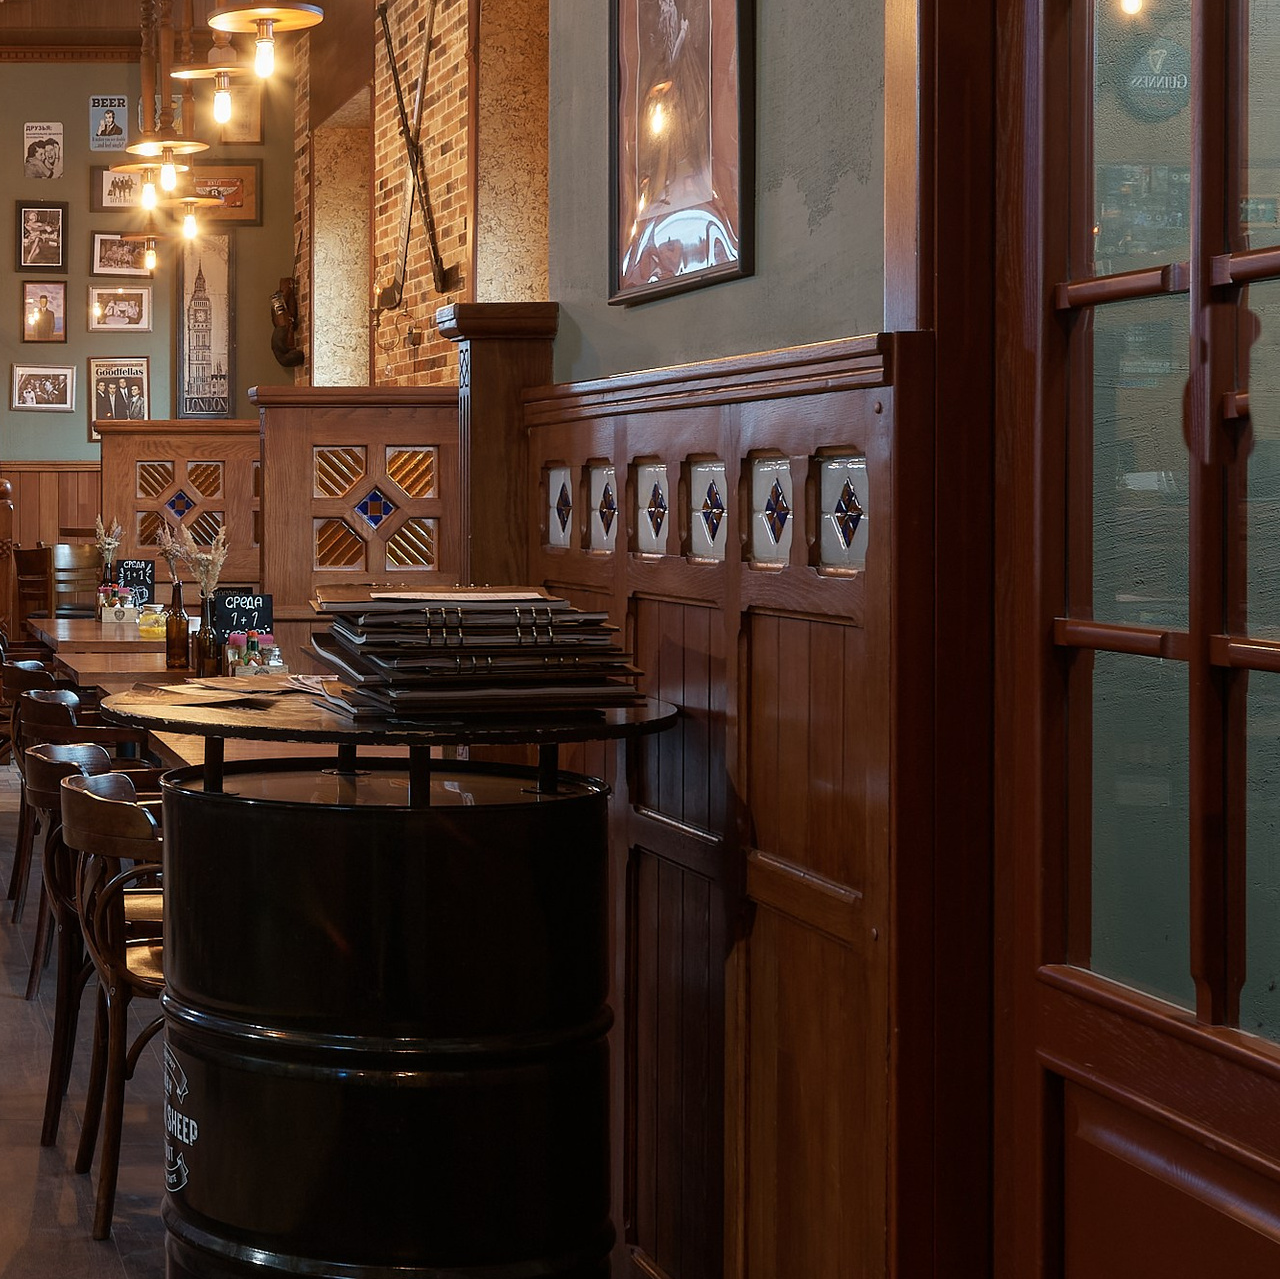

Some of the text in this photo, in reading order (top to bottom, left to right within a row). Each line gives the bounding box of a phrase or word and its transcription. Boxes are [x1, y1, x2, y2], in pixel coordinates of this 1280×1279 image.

[91, 98, 126, 108] BEER
[95, 367, 144, 376] Goodfellas
[186, 398, 228, 412] LONDON
[123, 560, 146, 569] СРЕДА
[167, 1103, 198, 1147] SHEEP
